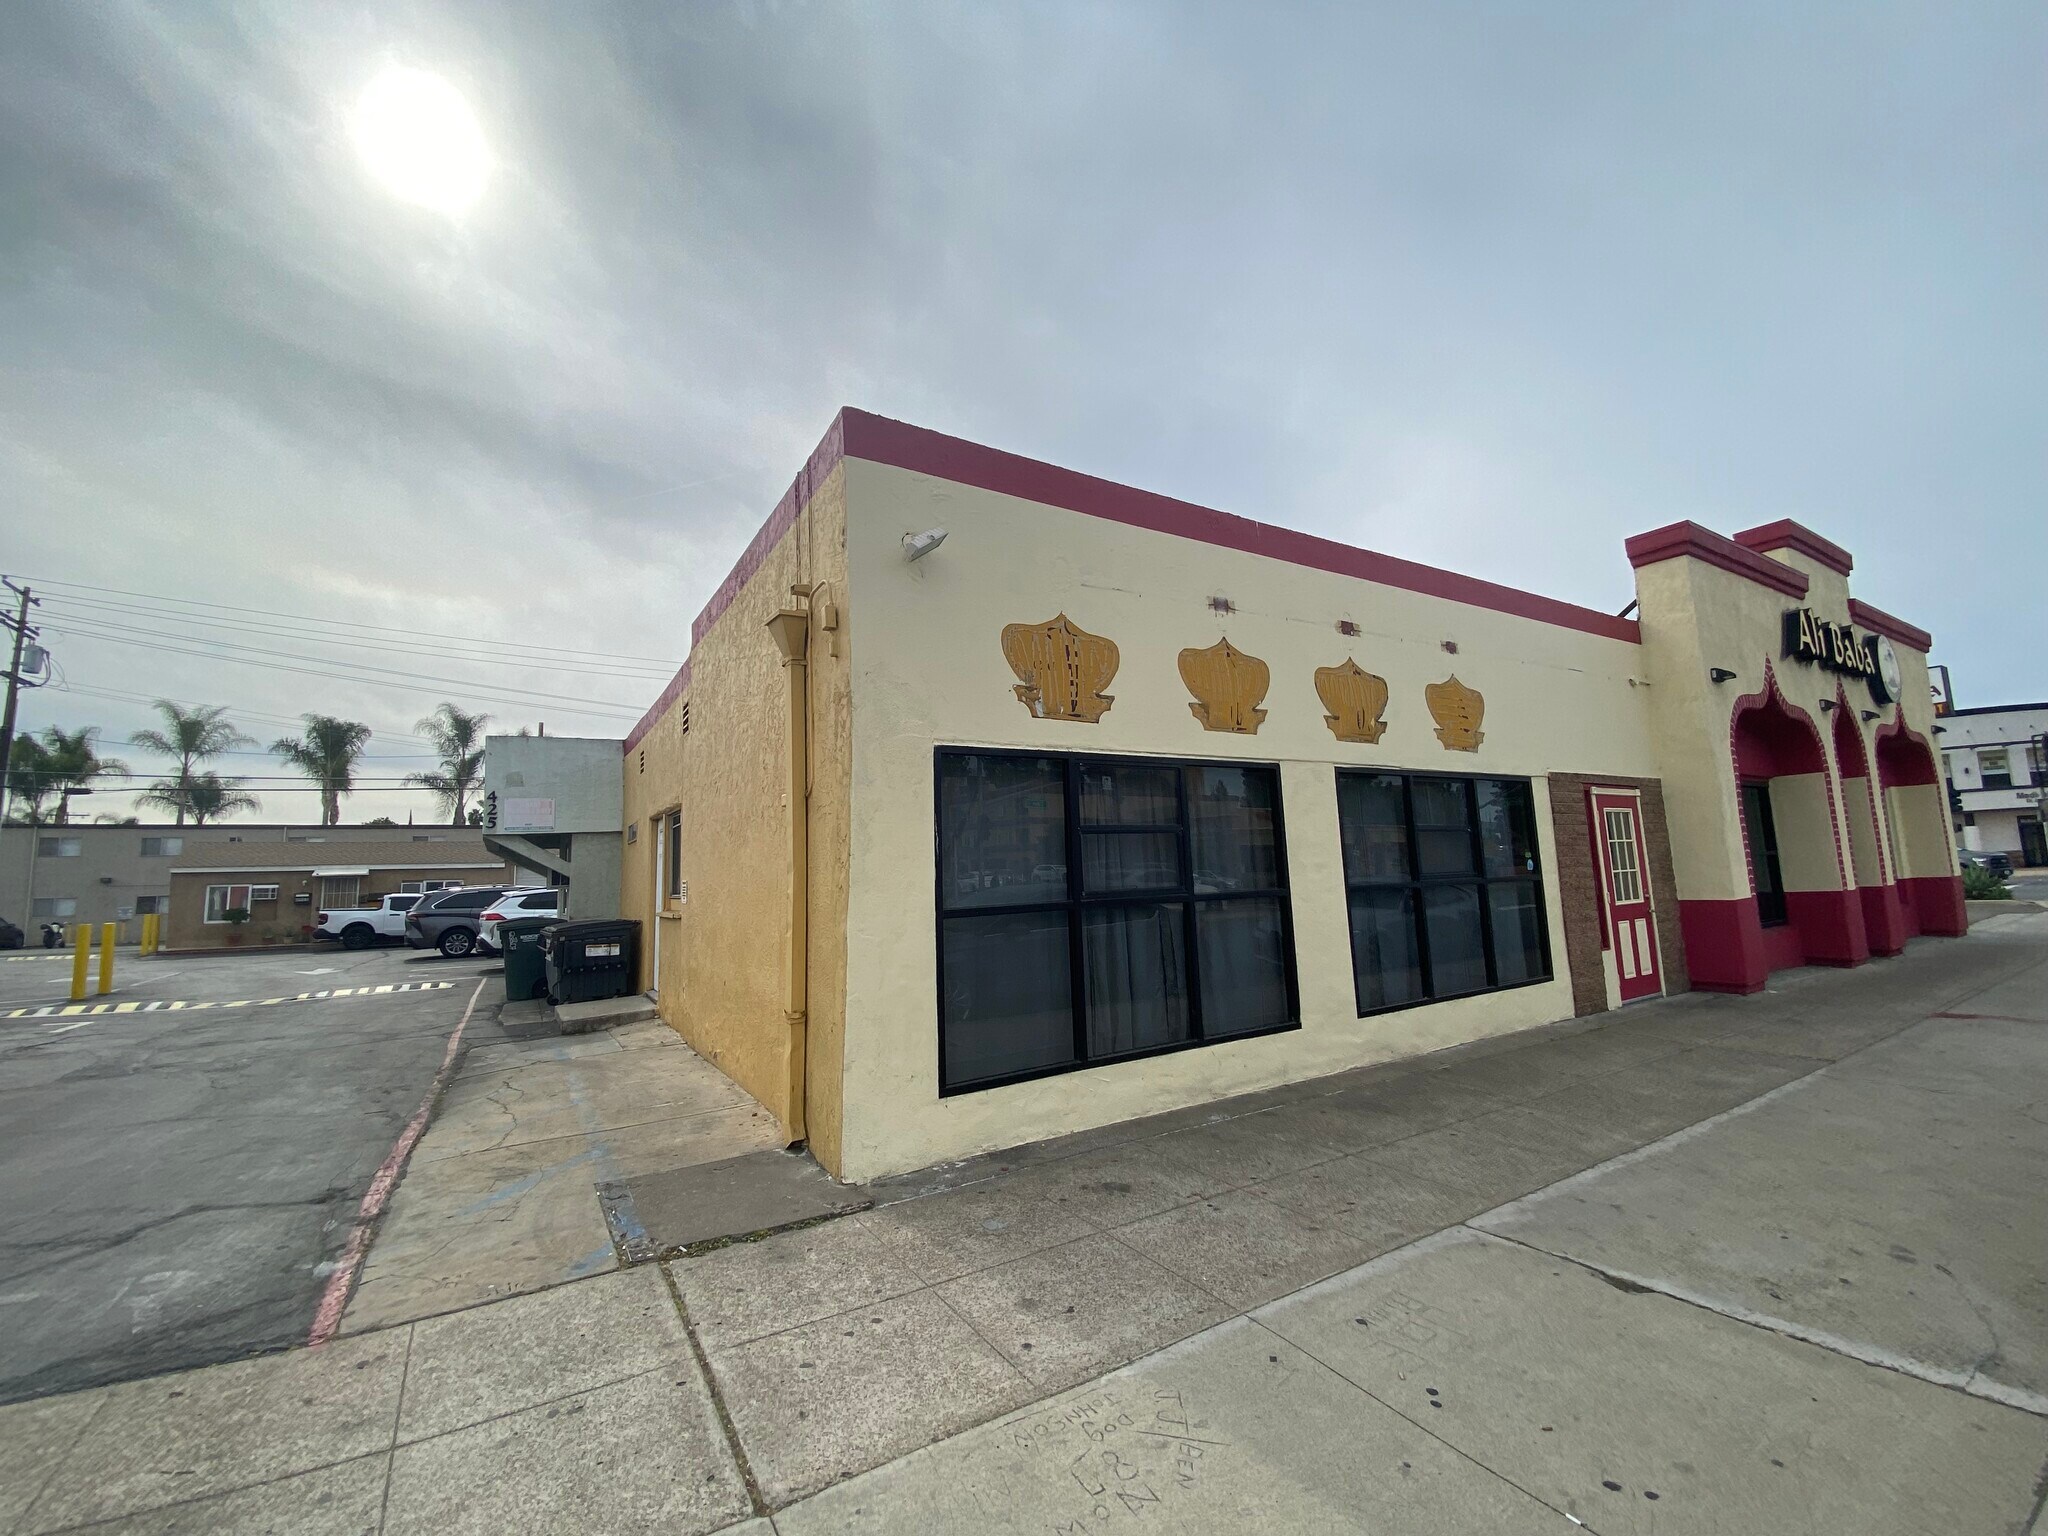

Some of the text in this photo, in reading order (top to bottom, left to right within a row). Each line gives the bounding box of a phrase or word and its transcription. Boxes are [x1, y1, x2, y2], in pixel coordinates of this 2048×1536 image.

[1799, 609, 1875, 674] Ali Baba
[486, 790, 498, 829] 425
